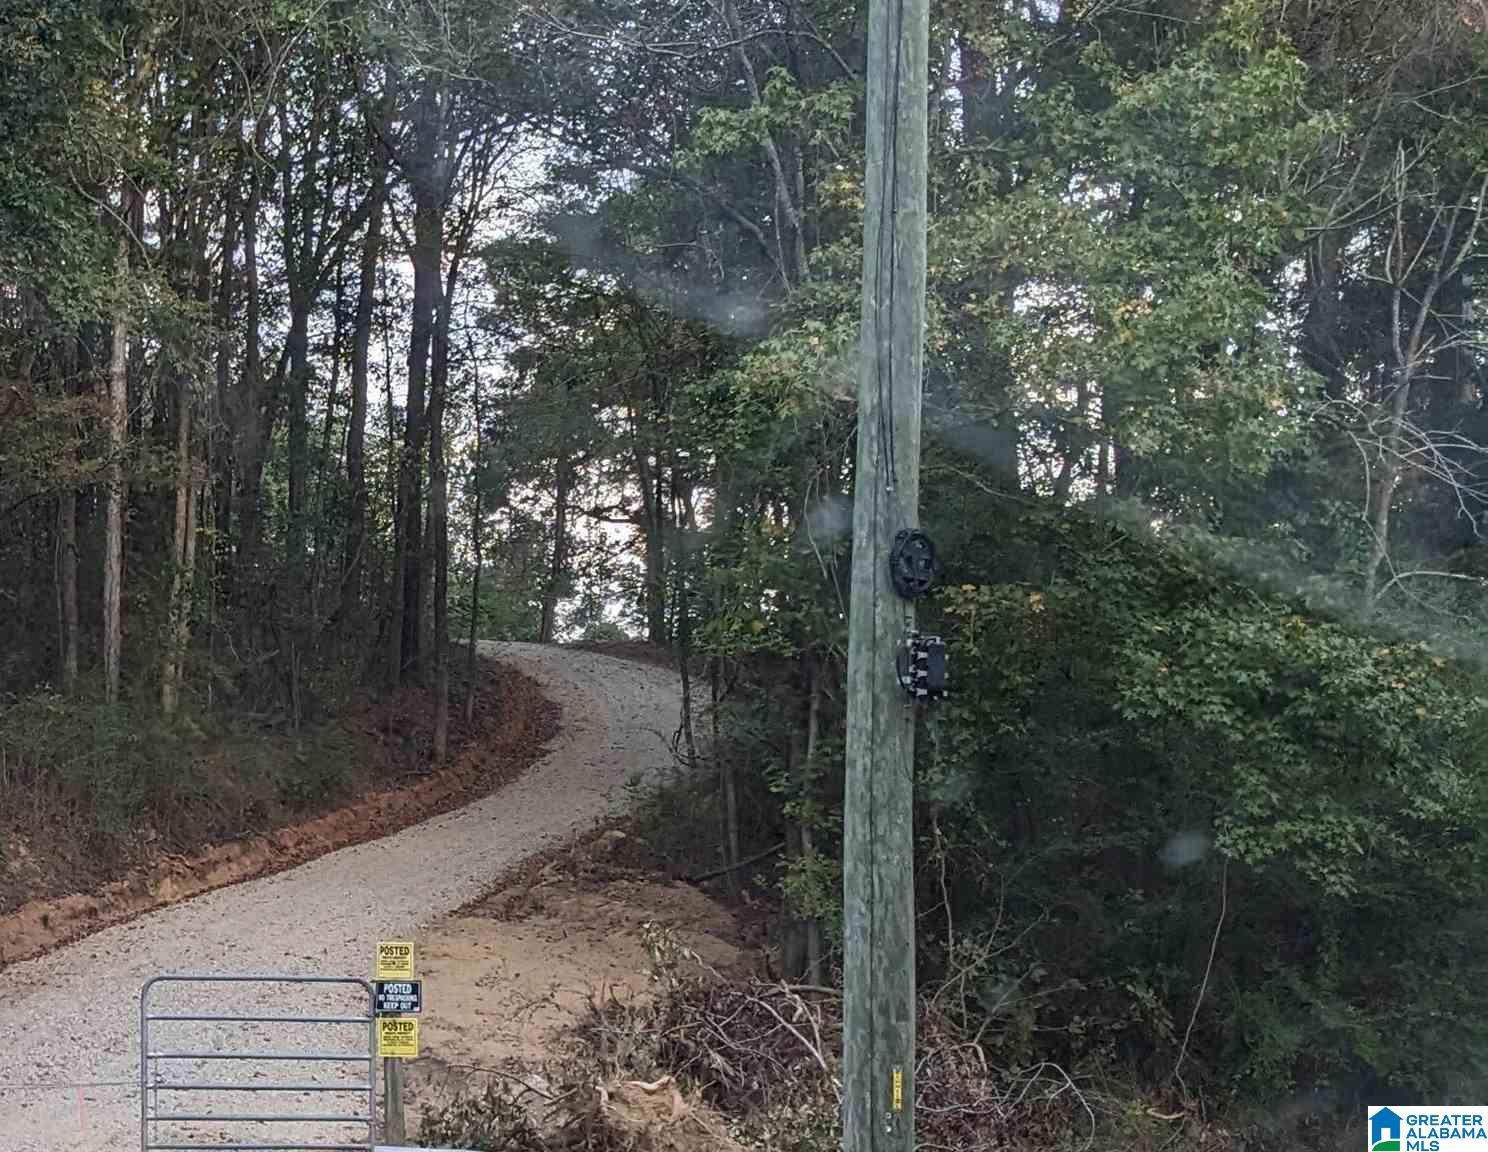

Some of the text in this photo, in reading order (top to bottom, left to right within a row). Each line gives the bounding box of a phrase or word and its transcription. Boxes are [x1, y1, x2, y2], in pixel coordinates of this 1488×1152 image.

[380, 945, 410, 956] POSTED
[383, 984, 412, 994] POSTED
[383, 1002, 412, 1010] KEEP OUT
[382, 1022, 414, 1032] POSTED
